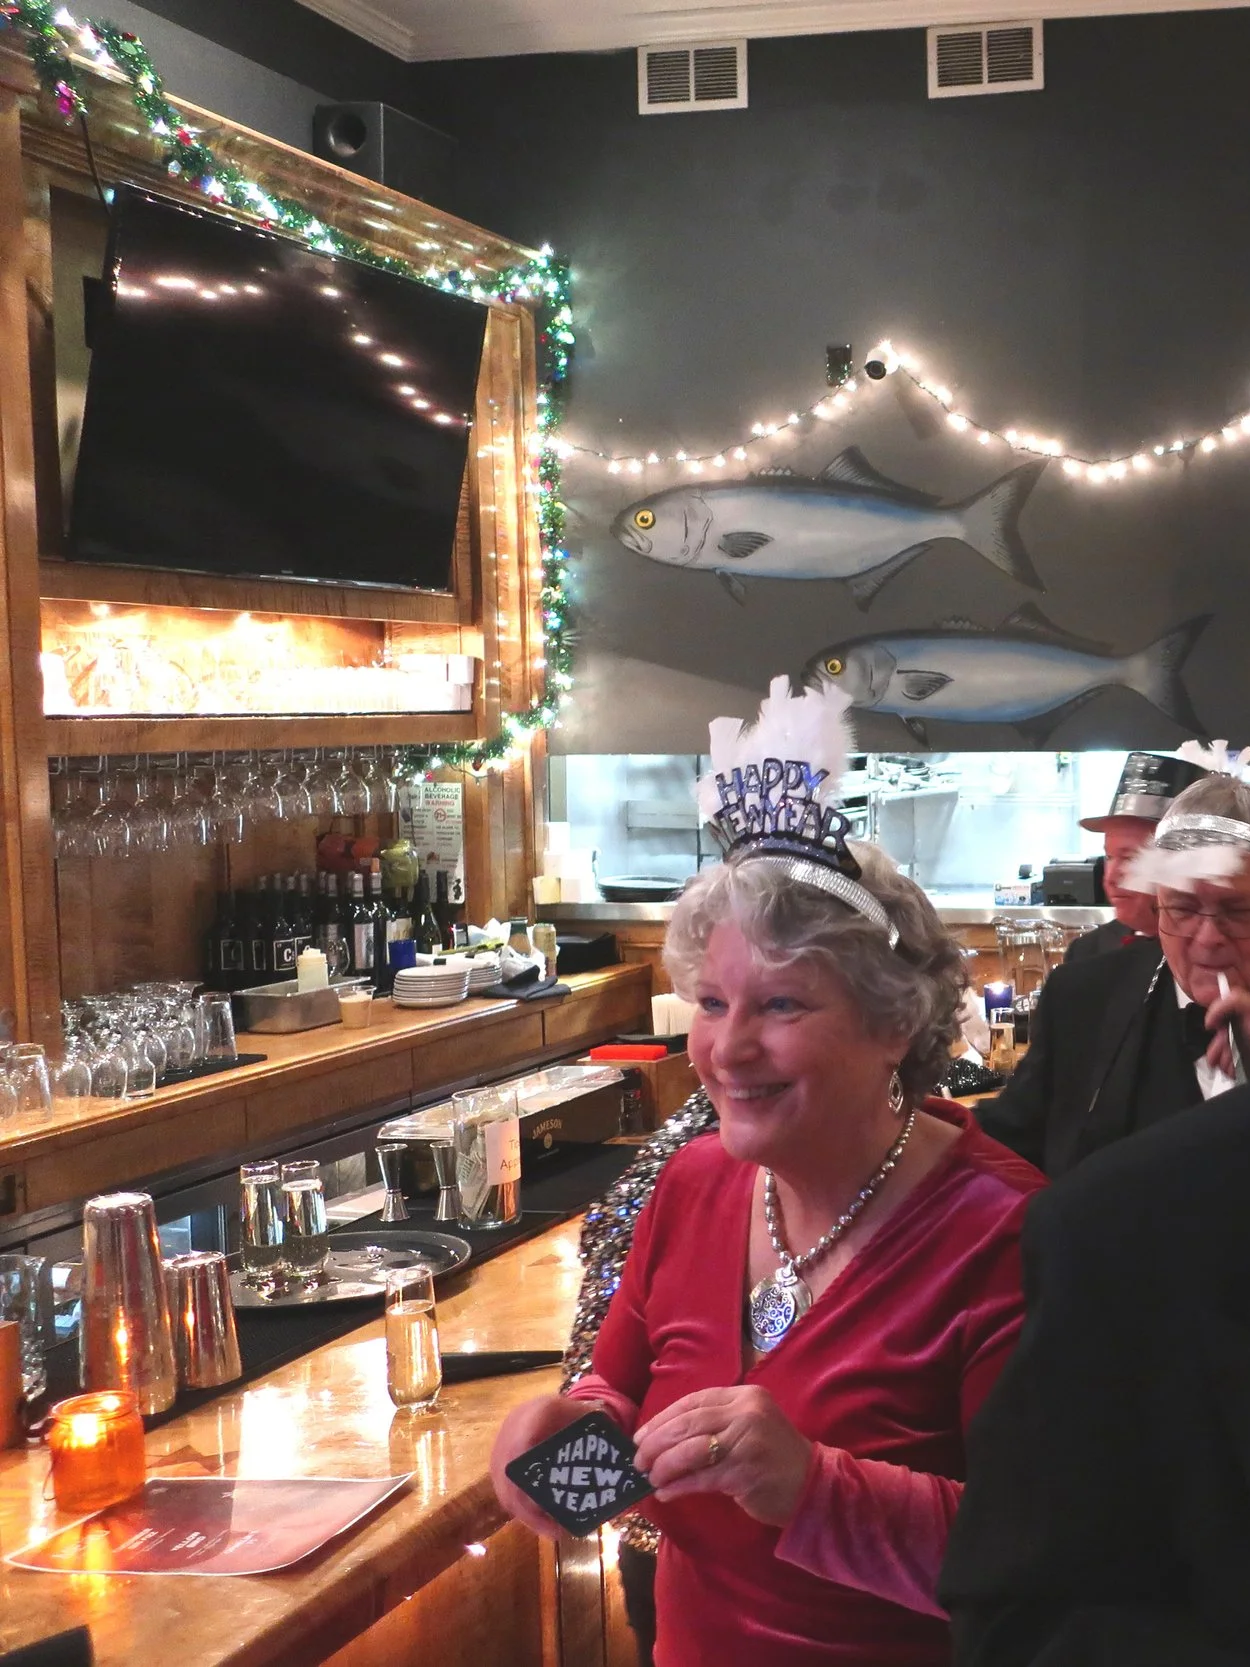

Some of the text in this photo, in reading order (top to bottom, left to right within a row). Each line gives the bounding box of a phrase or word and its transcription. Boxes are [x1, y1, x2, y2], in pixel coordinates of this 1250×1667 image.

[715, 757, 830, 806] HAPPY
[707, 797, 851, 854] NEW YEAR
[532, 1119, 562, 1139] JAMESON
[557, 1434, 620, 1464] HAPPY
[549, 1466, 623, 1486] NEW
[551, 1487, 617, 1512] YEAR
